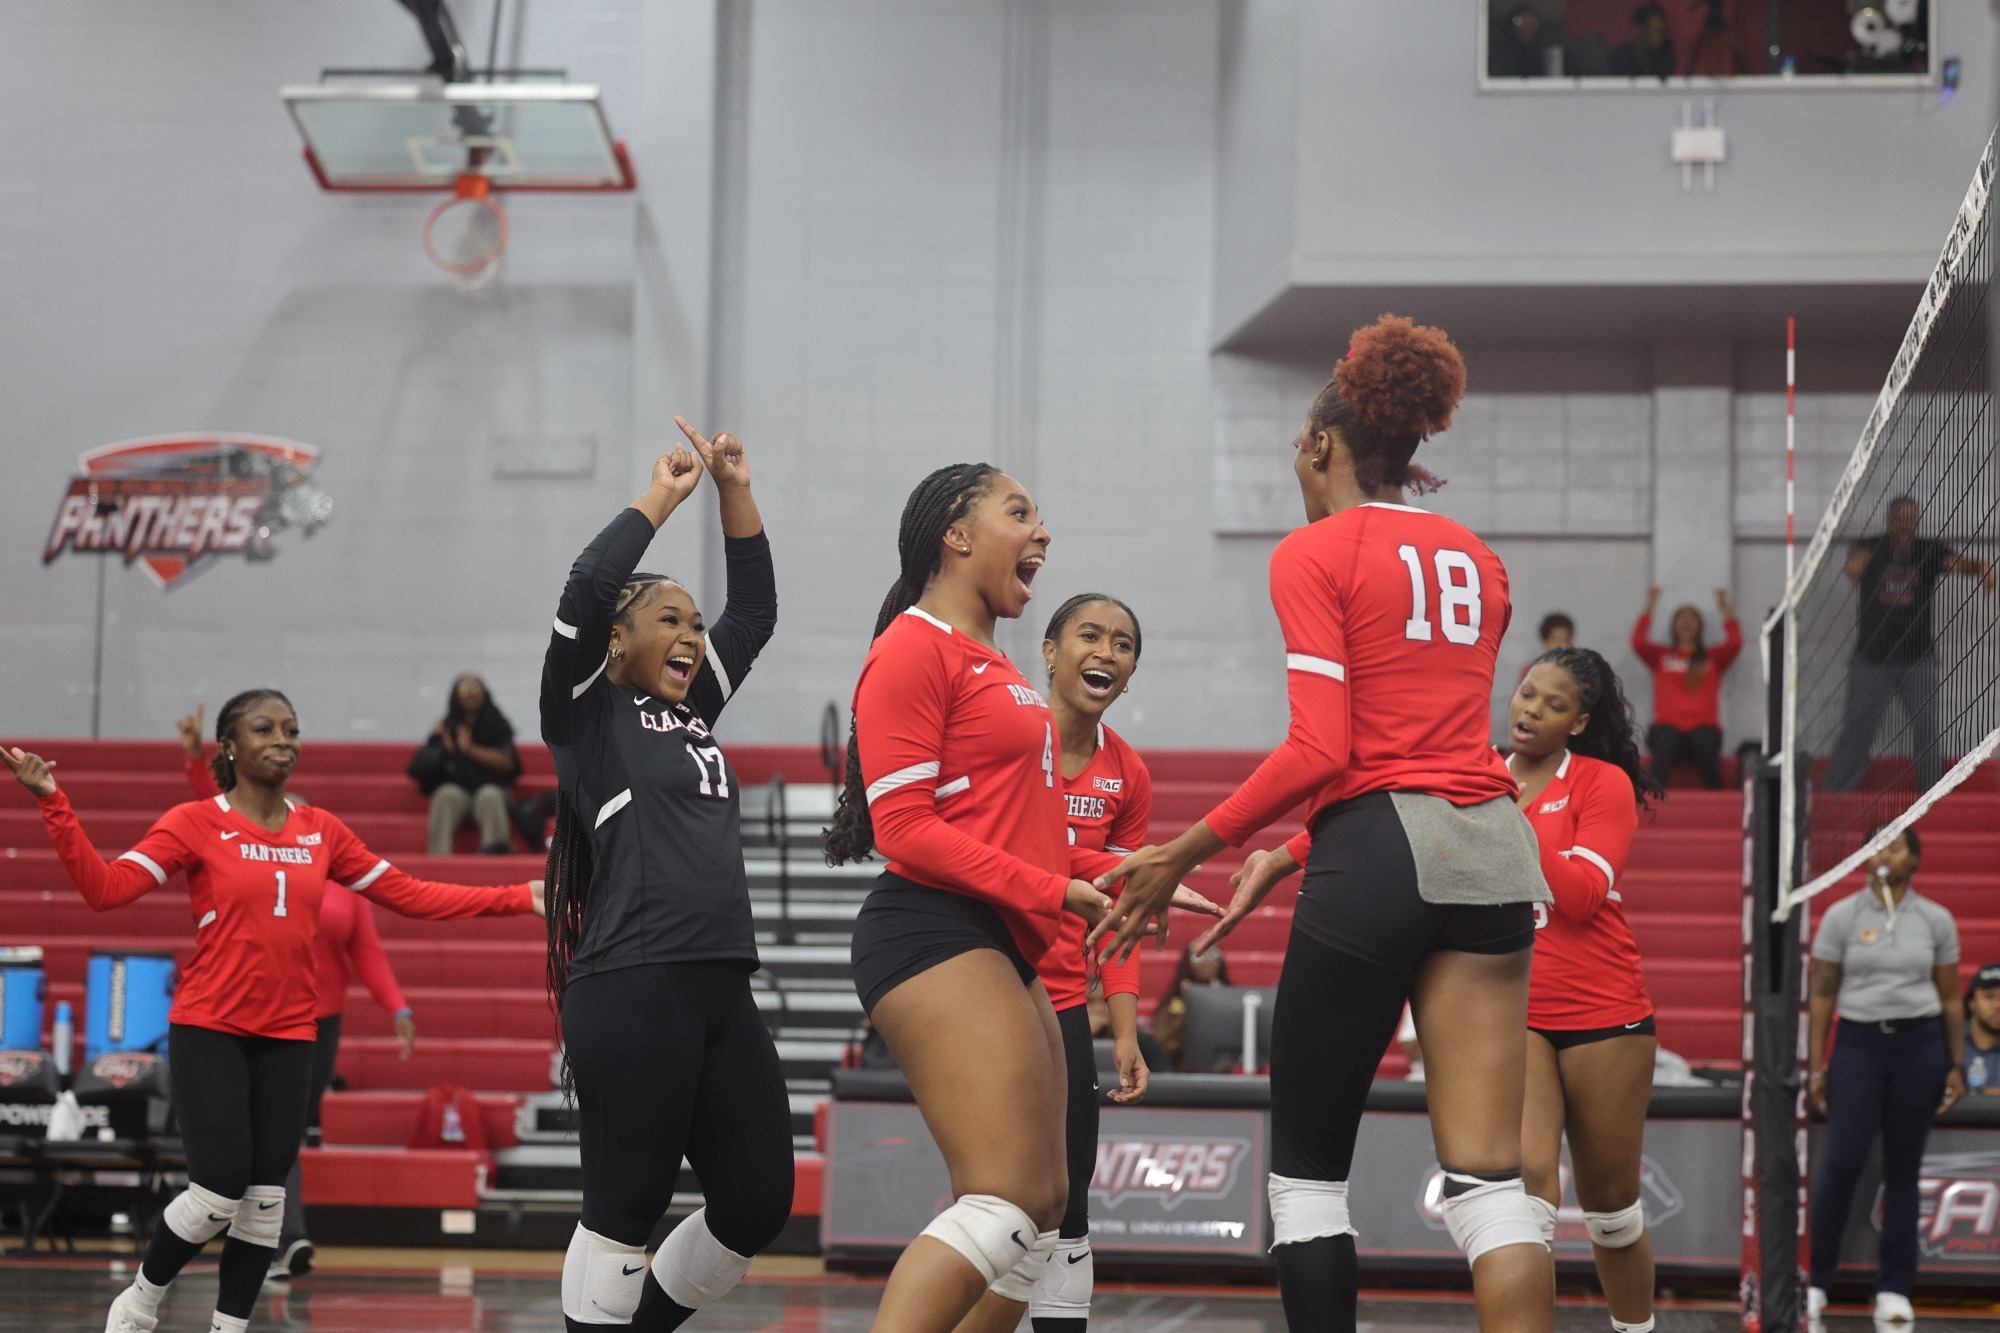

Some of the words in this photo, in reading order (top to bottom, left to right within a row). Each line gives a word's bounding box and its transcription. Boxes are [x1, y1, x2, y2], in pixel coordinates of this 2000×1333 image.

[44, 494, 262, 564] PANTHERS
[1398, 544, 1483, 647] 18
[685, 742, 729, 799] 17
[1042, 721, 1054, 789] 4
[1064, 794, 1106, 819] HERS
[1094, 777, 1121, 792] SIAC
[240, 843, 312, 865] PANTHERS
[273, 869, 288, 917] 1
